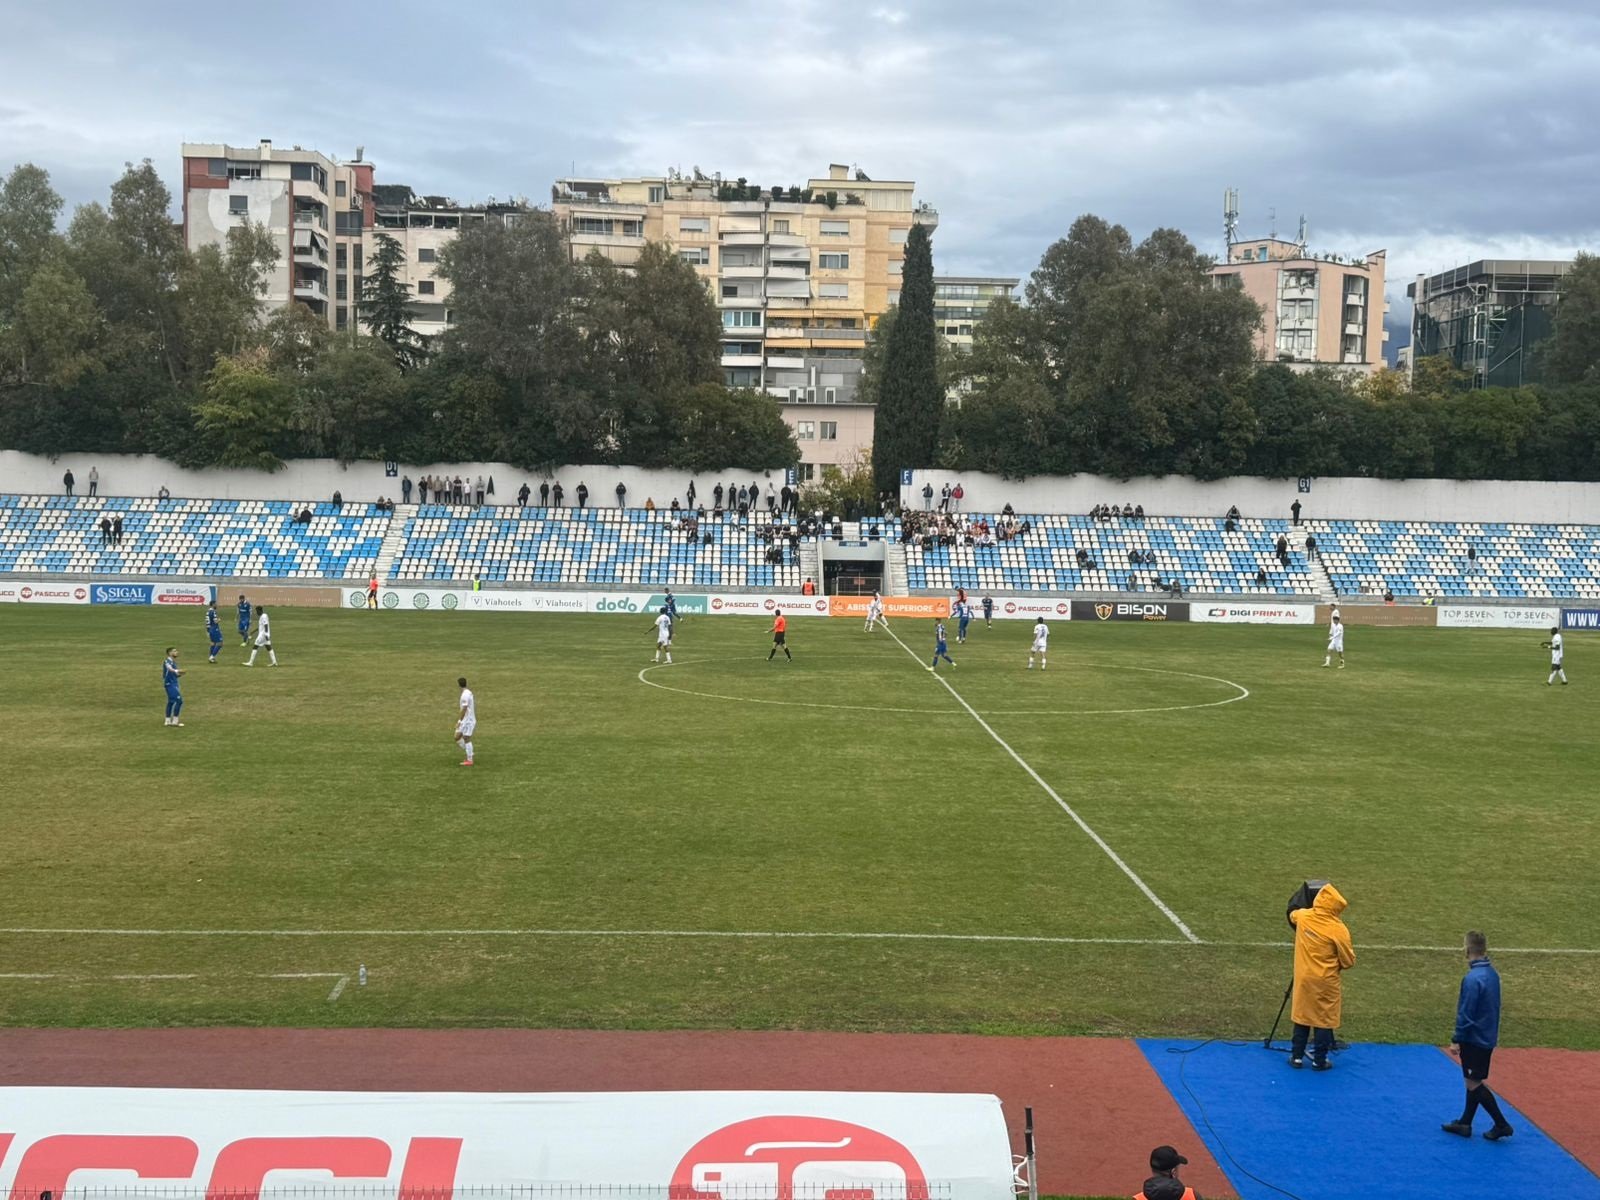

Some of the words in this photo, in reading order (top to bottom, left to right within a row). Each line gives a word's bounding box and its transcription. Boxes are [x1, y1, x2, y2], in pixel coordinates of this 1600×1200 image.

[386, 461, 397, 470] D1
[904, 470, 909, 480] F
[1300, 478, 1309, 488] G1
[108, 587, 146, 598] SIGAL
[485, 598, 522, 606] Viahotels
[546, 599, 583, 607] Viahotels
[596, 597, 637, 612] dodo
[888, 604, 934, 613] SUPERIORE
[1117, 604, 1167, 615] BISON
[1285, 610, 1298, 618] AL
[1443, 610, 1461, 618] TOP
[1464, 610, 1495, 618] SEVEN
[1524, 611, 1555, 620] SEVEN
